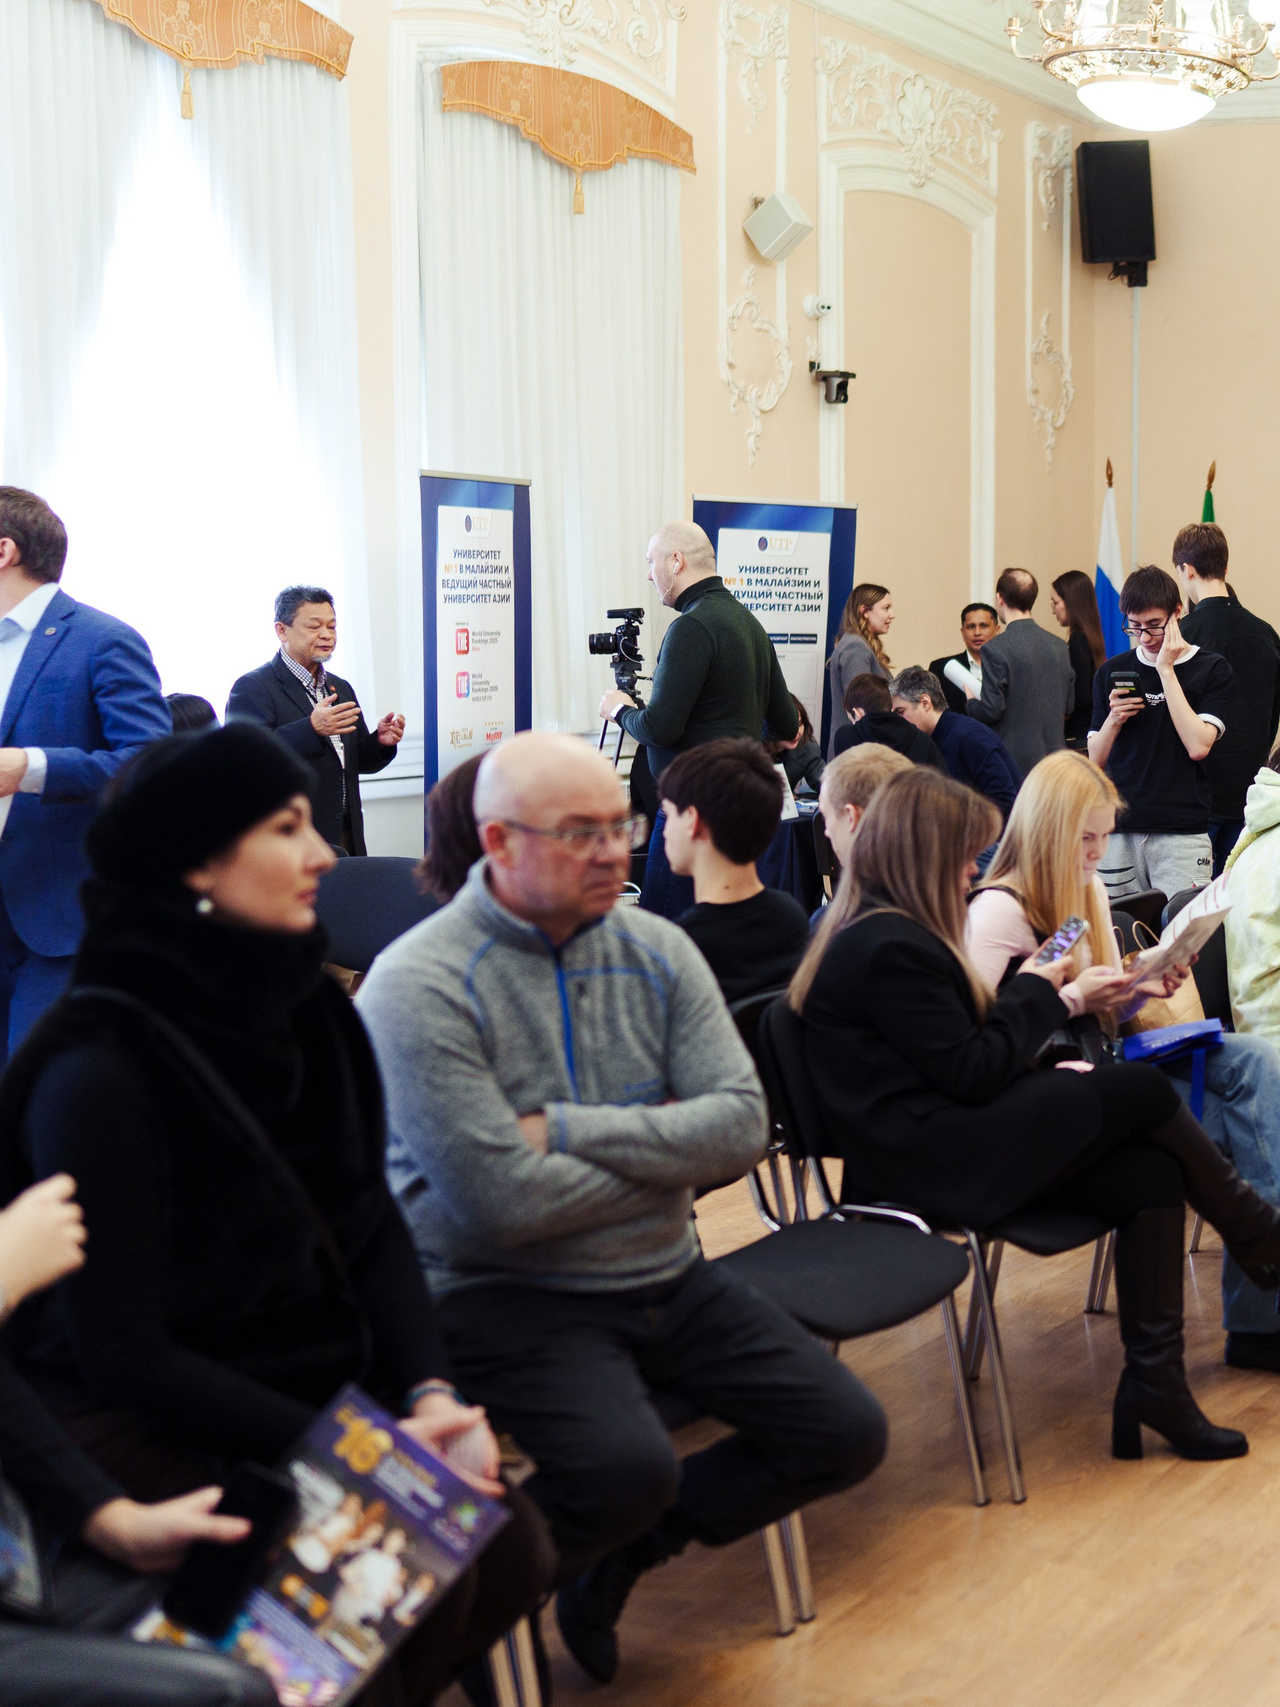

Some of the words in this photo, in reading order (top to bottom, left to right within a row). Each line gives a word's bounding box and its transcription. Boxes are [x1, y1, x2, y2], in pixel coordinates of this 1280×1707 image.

[472, 517, 488, 531] UTP
[769, 538, 793, 549] UTP
[453, 549, 501, 560] УНИВЕРСИТЕТ
[465, 562, 503, 574] МАЛАЙЗИИ
[504, 565, 510, 574] И
[738, 565, 809, 576] УНИВЕРСИТЕТ
[441, 576, 478, 590] ВЕДУЩИЙ
[479, 577, 512, 589] ЧАСТНЫЙ
[747, 578, 753, 586] В
[755, 576, 812, 588] МАЛАЙЗИИ
[813, 580, 820, 588] И
[443, 594, 492, 604] УНИВЕРСИТЕТ
[492, 594, 511, 604] АЗИИ
[733, 589, 772, 600] ДУЩИЙ
[775, 590, 824, 600] ЧАСТНЫЙ
[743, 603, 793, 612] ВЕРСИТЕТ
[794, 603, 821, 612] АЗИИ
[457, 632, 468, 651] THE
[458, 675, 469, 694] THE
